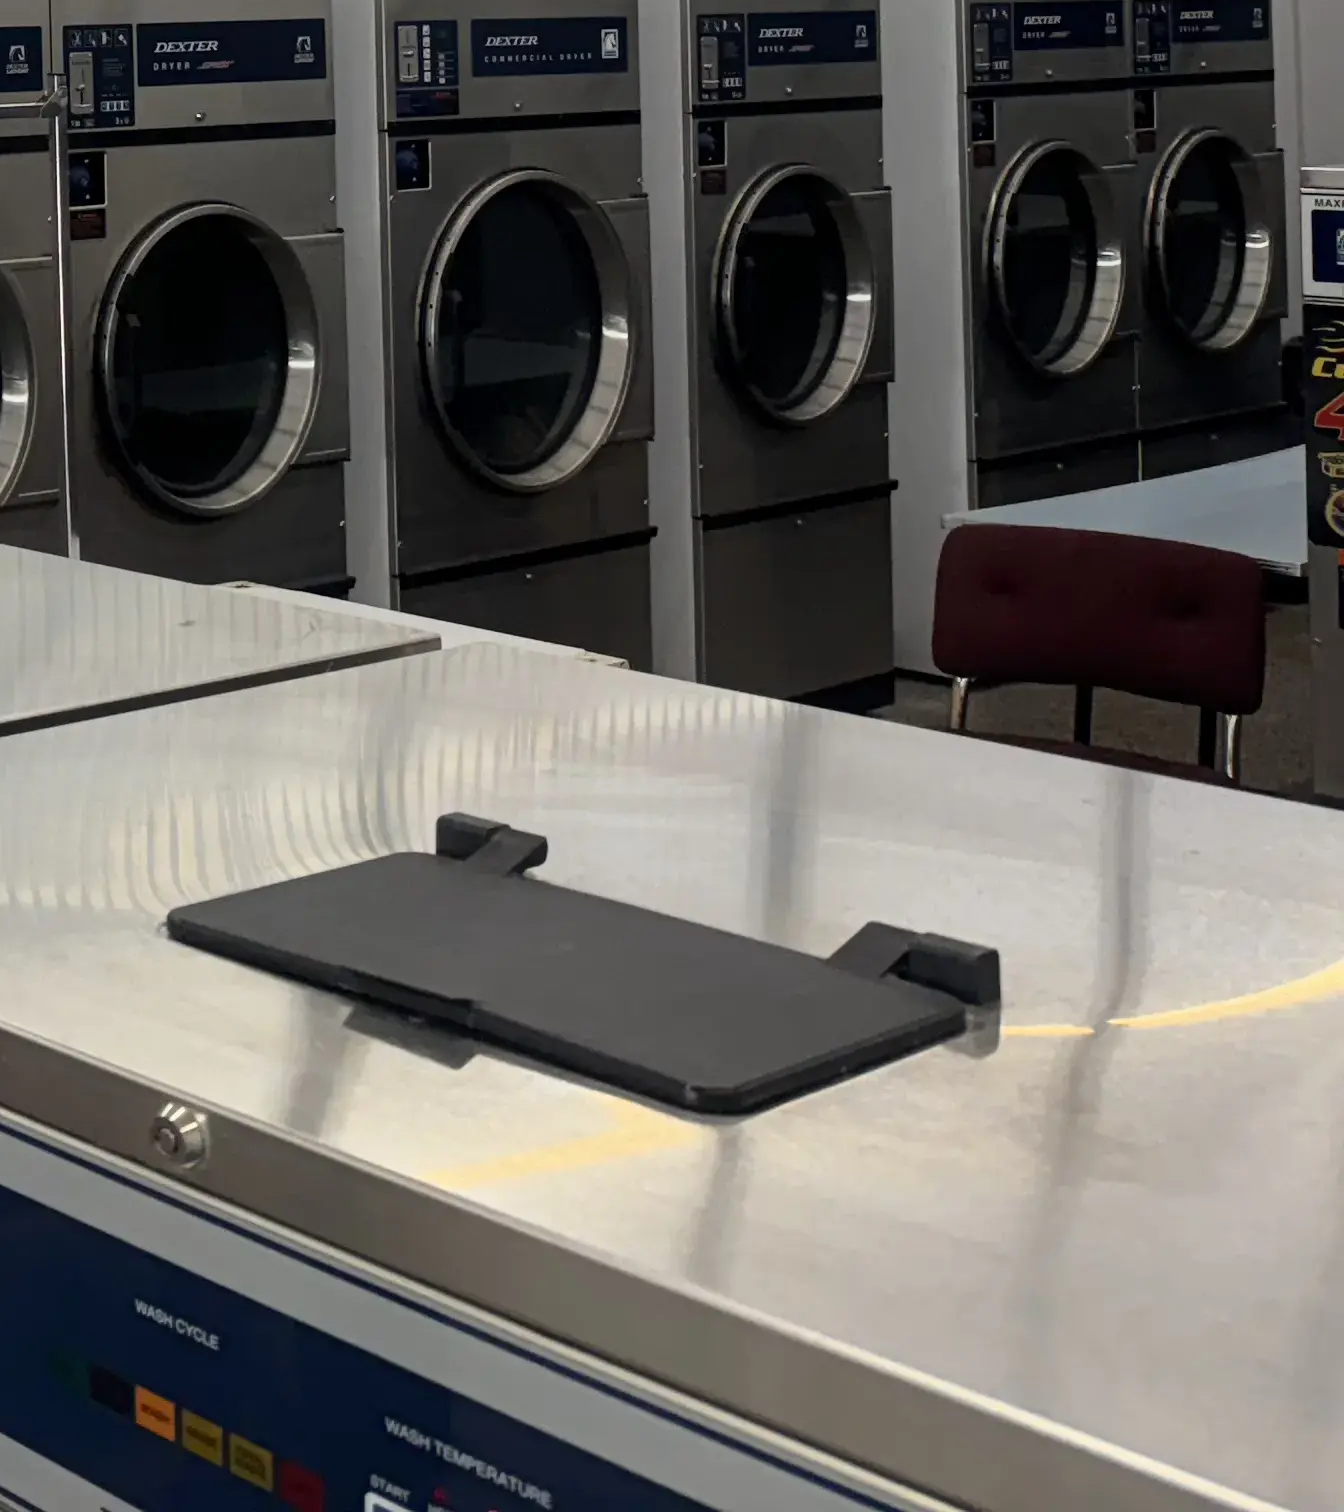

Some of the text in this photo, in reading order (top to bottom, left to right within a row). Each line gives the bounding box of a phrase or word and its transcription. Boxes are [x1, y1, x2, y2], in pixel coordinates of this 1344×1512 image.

[1023, 15, 1062, 25] DEXTER
[759, 27, 804, 38] DEXTER
[154, 40, 219, 53] DEXTER
[485, 36, 539, 47] DEXTER
[484, 53, 554, 63] COMMERCIAL
[153, 61, 191, 71] DRYER
[134, 1298, 220, 1351] WASH CYCLE
[383, 1415, 554, 1511] WASH TEMPERATURE
[369, 1473, 411, 1503] START
